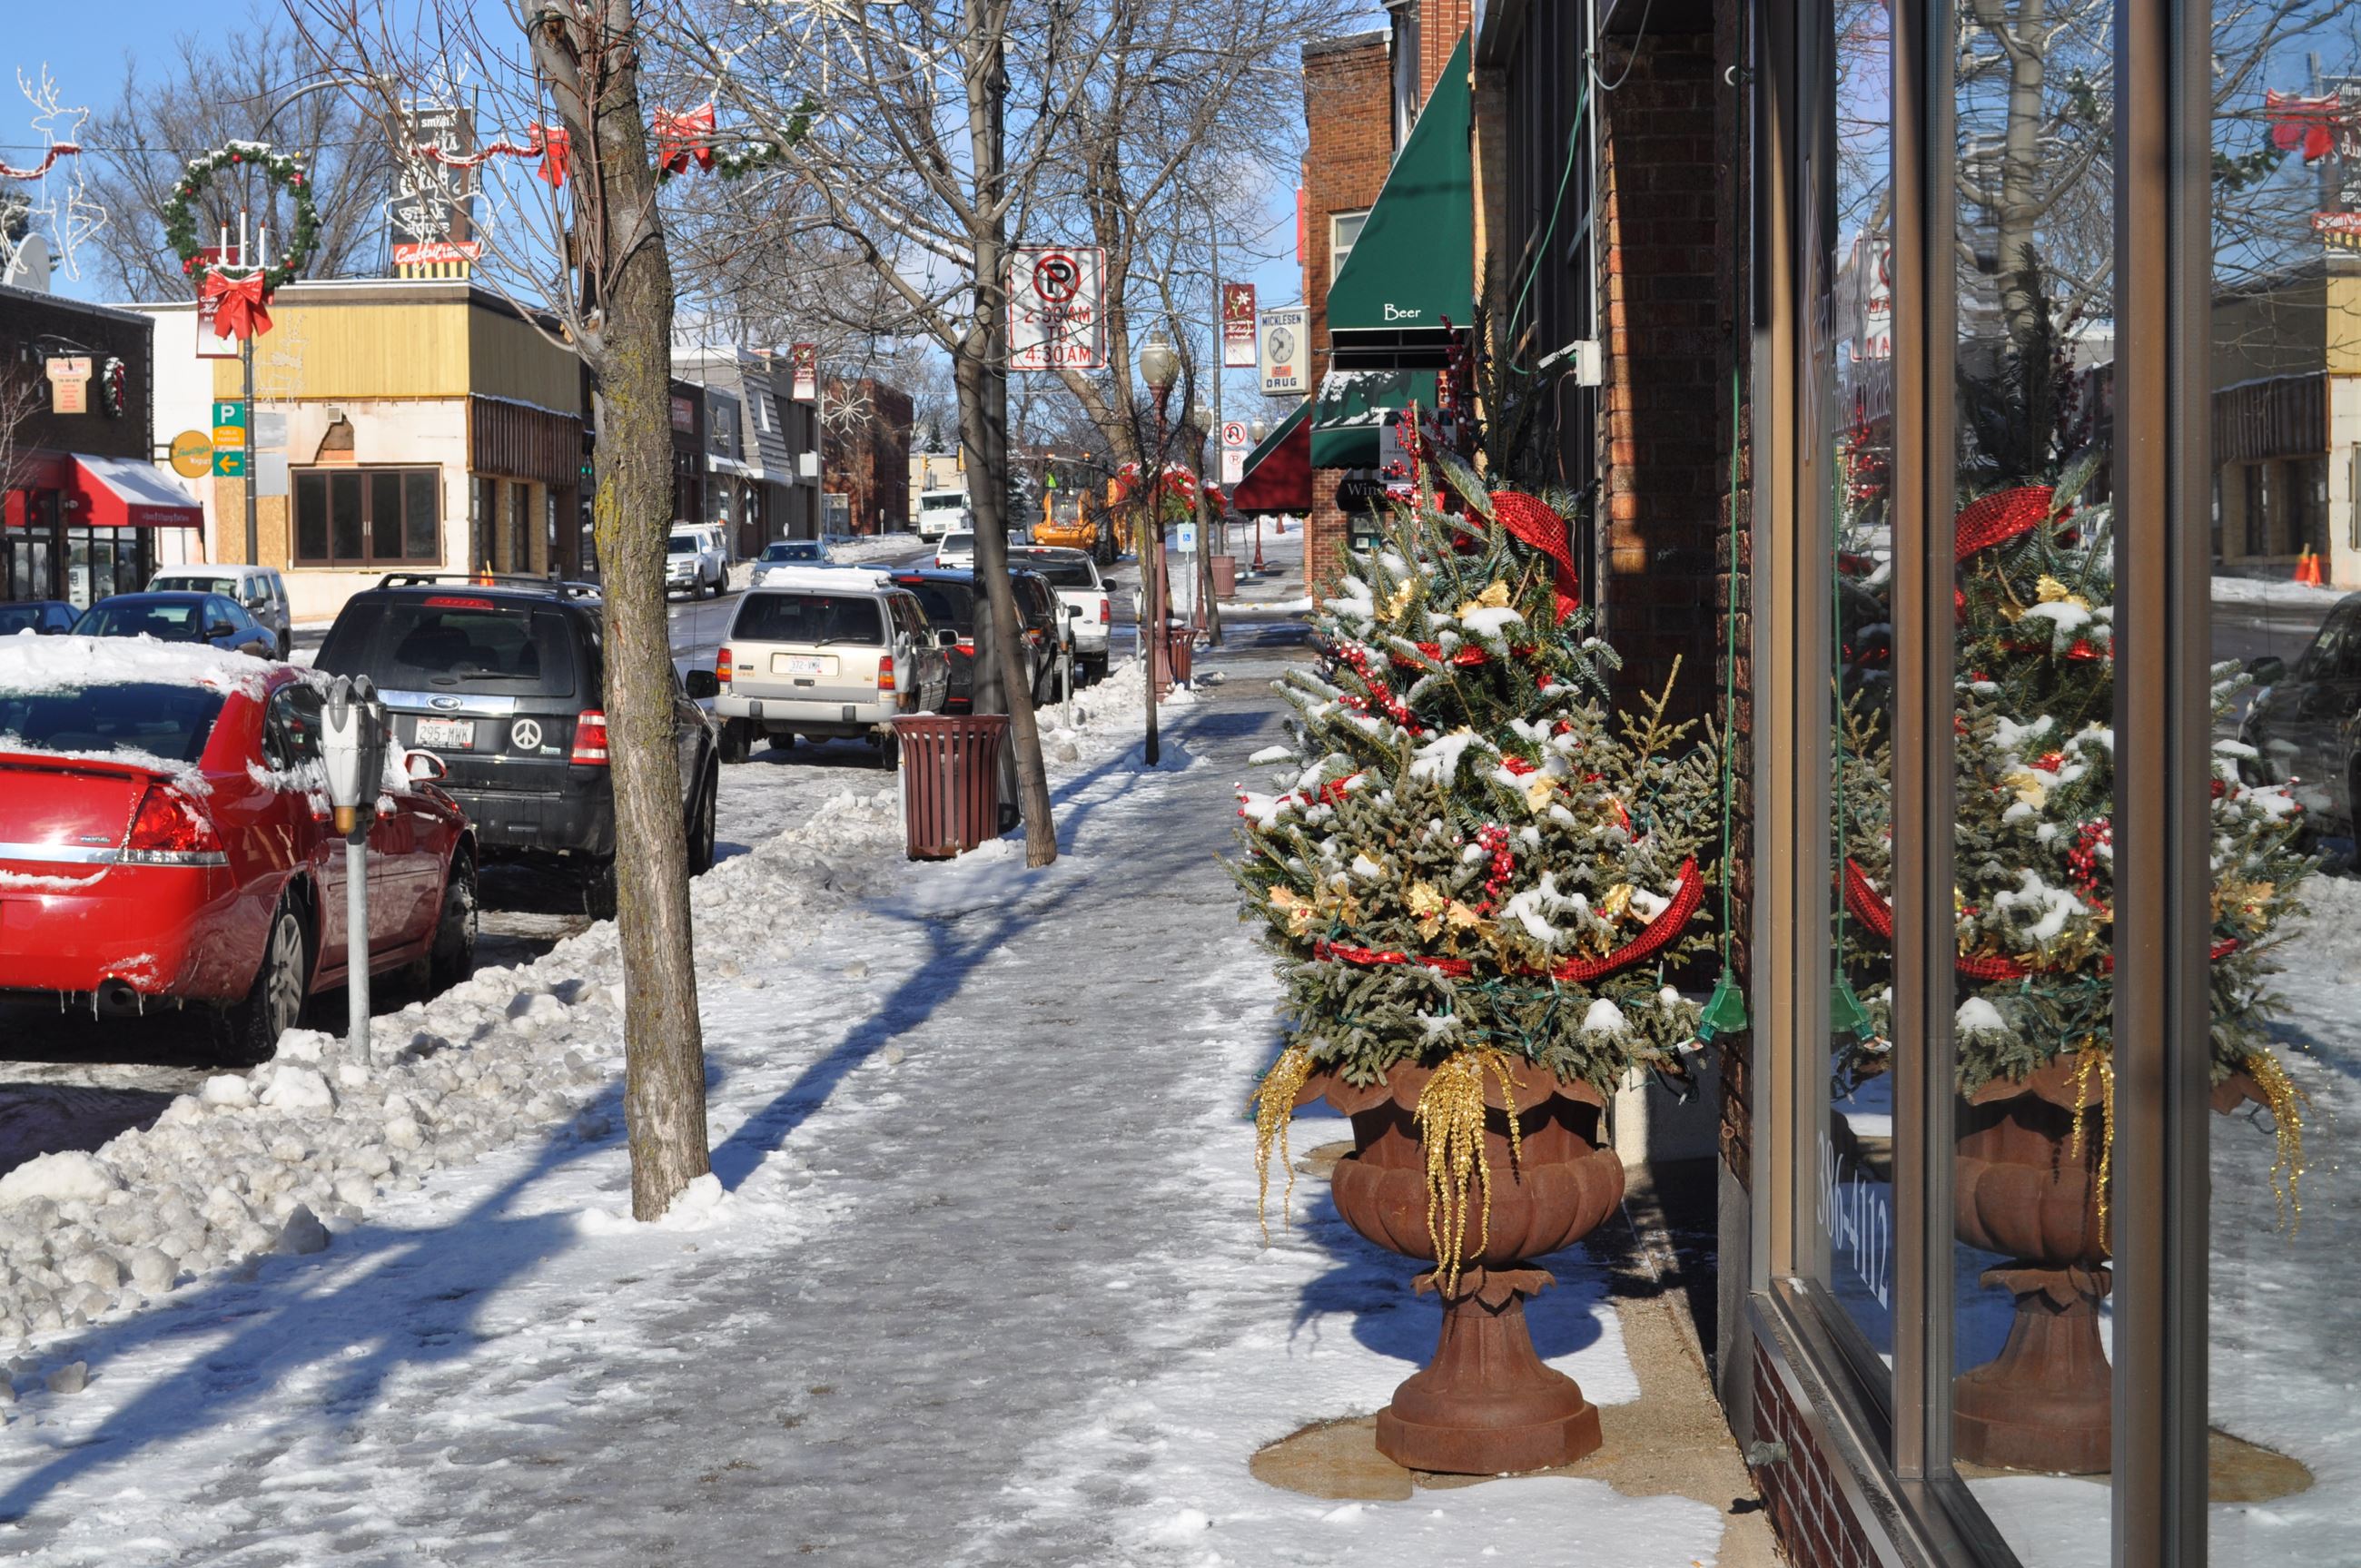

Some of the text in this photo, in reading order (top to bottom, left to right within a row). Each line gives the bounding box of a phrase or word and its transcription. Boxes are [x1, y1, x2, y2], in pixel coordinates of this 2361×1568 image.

[1261, 313, 1301, 327] MICKLESEN
[1384, 303, 1422, 321] Beer
[1046, 325, 1068, 343] TO
[1024, 345, 1091, 363] 4:30AM
[1266, 377, 1297, 389] DRUG
[221, 405, 235, 424] P
[1817, 1129, 1888, 1311] 386-4112
